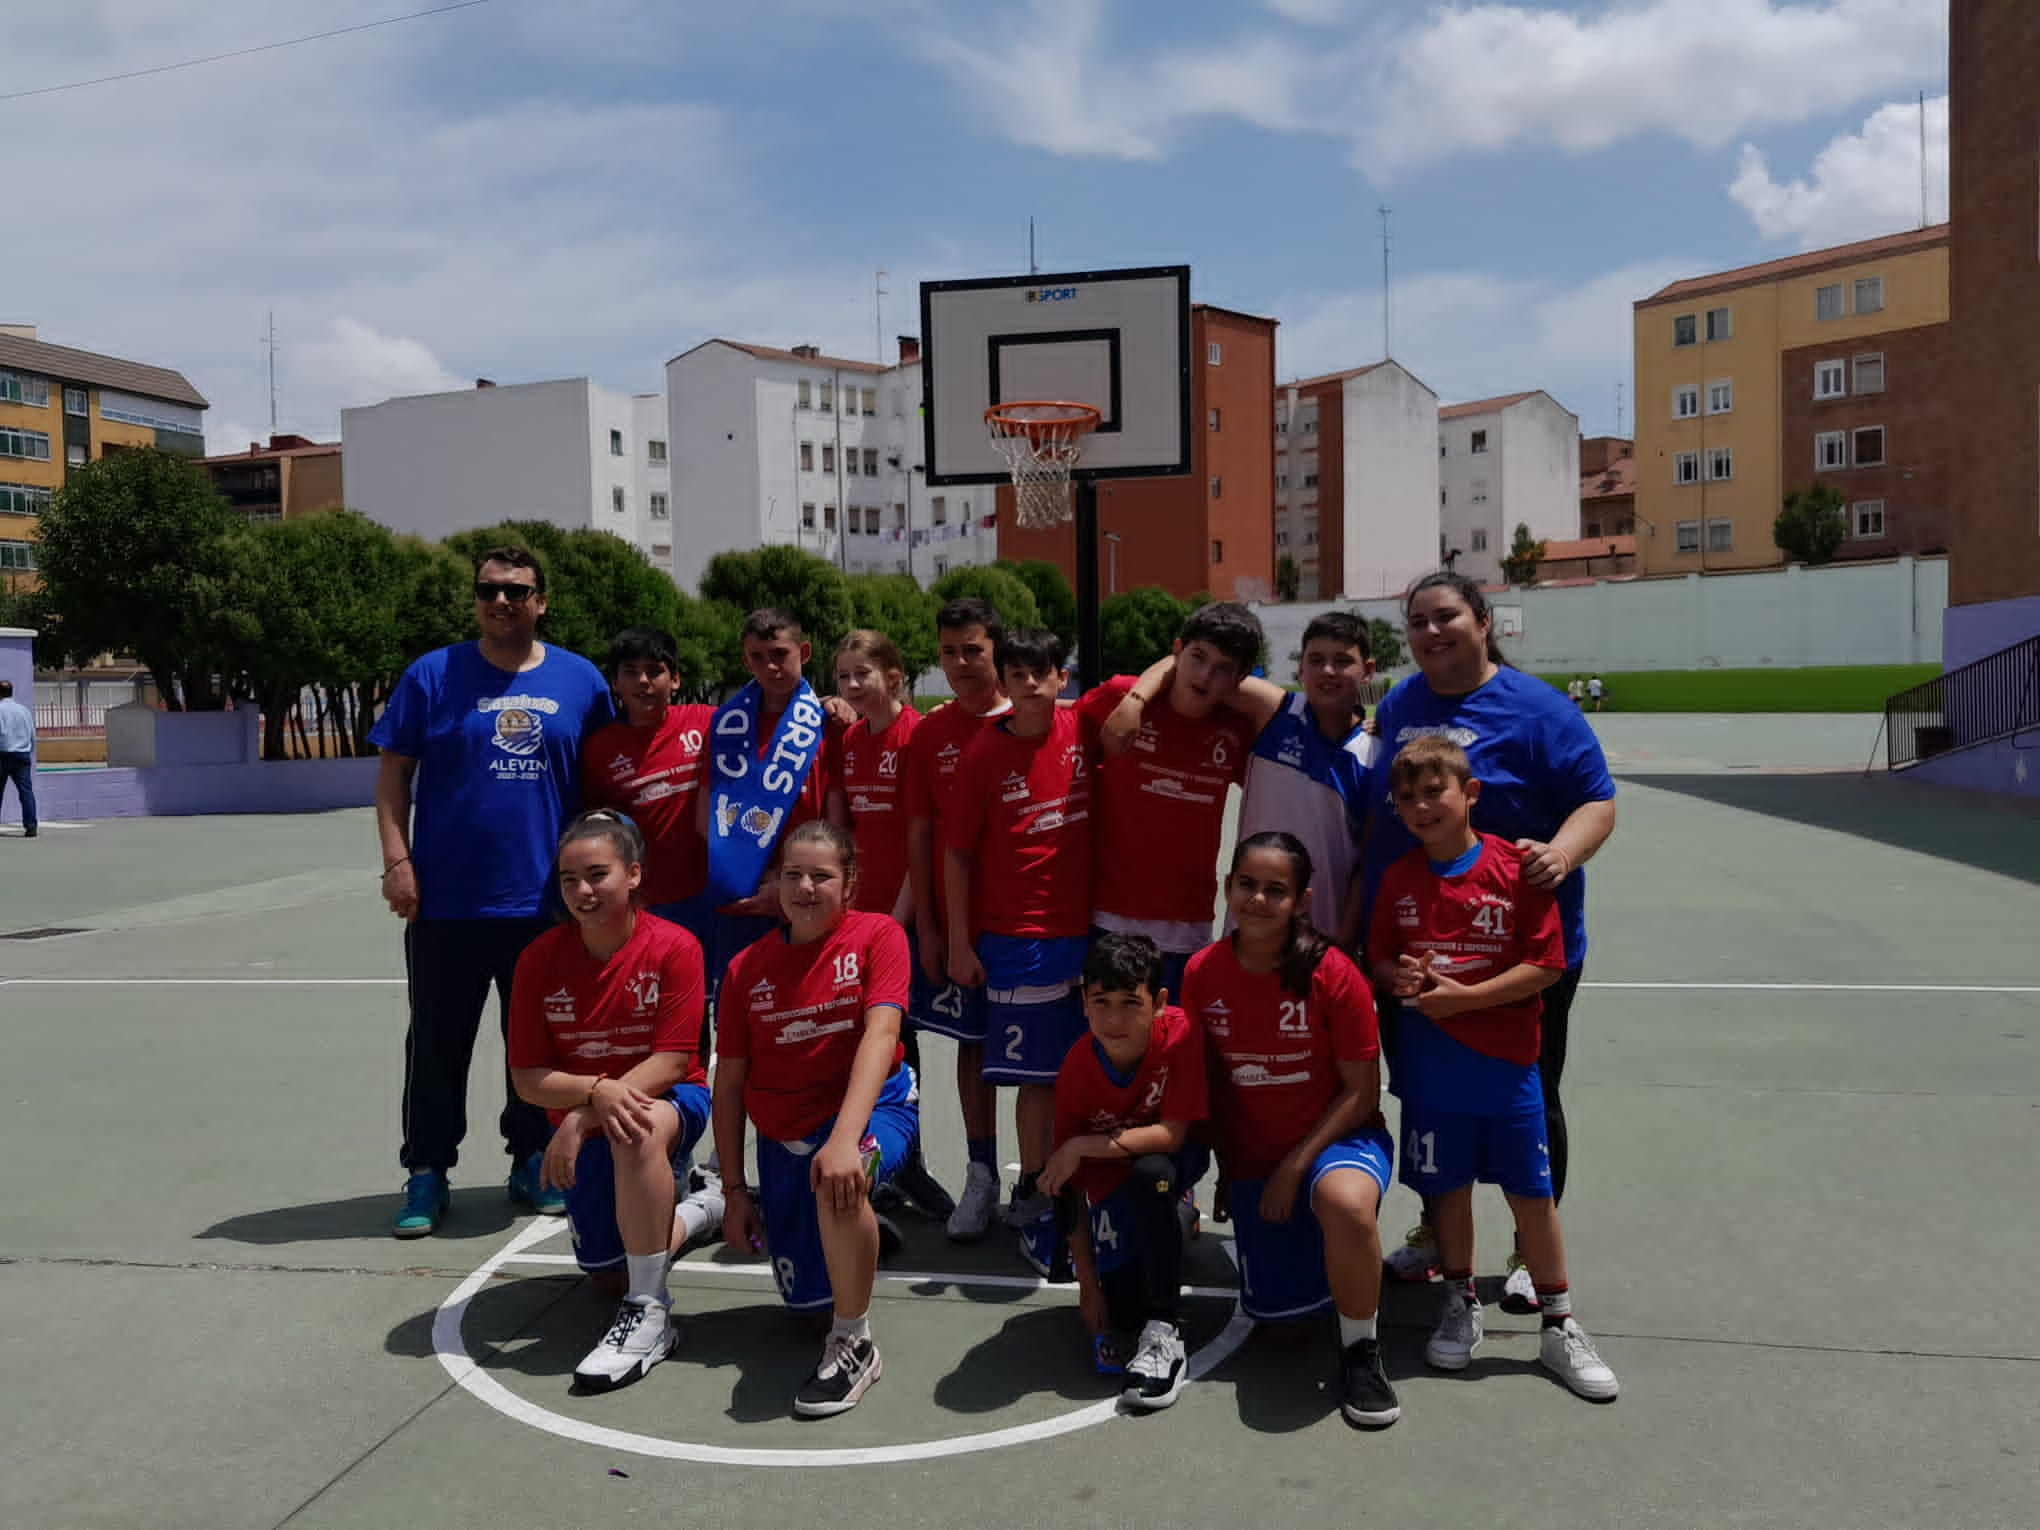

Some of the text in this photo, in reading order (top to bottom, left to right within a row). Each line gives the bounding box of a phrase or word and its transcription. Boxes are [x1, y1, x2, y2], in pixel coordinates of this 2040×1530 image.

[679, 728, 703, 753] 10
[1211, 738, 1227, 767] 6
[488, 758, 549, 772] ALEVIN
[879, 750, 897, 774] 20
[1072, 754, 1088, 779] 2
[1471, 904, 1505, 936] 41
[832, 952, 859, 983] 18
[632, 980, 660, 1012] 14
[1279, 999, 1309, 1032] 21
[1005, 1024, 1024, 1062] 2
[1405, 1128, 1440, 1174] 41
